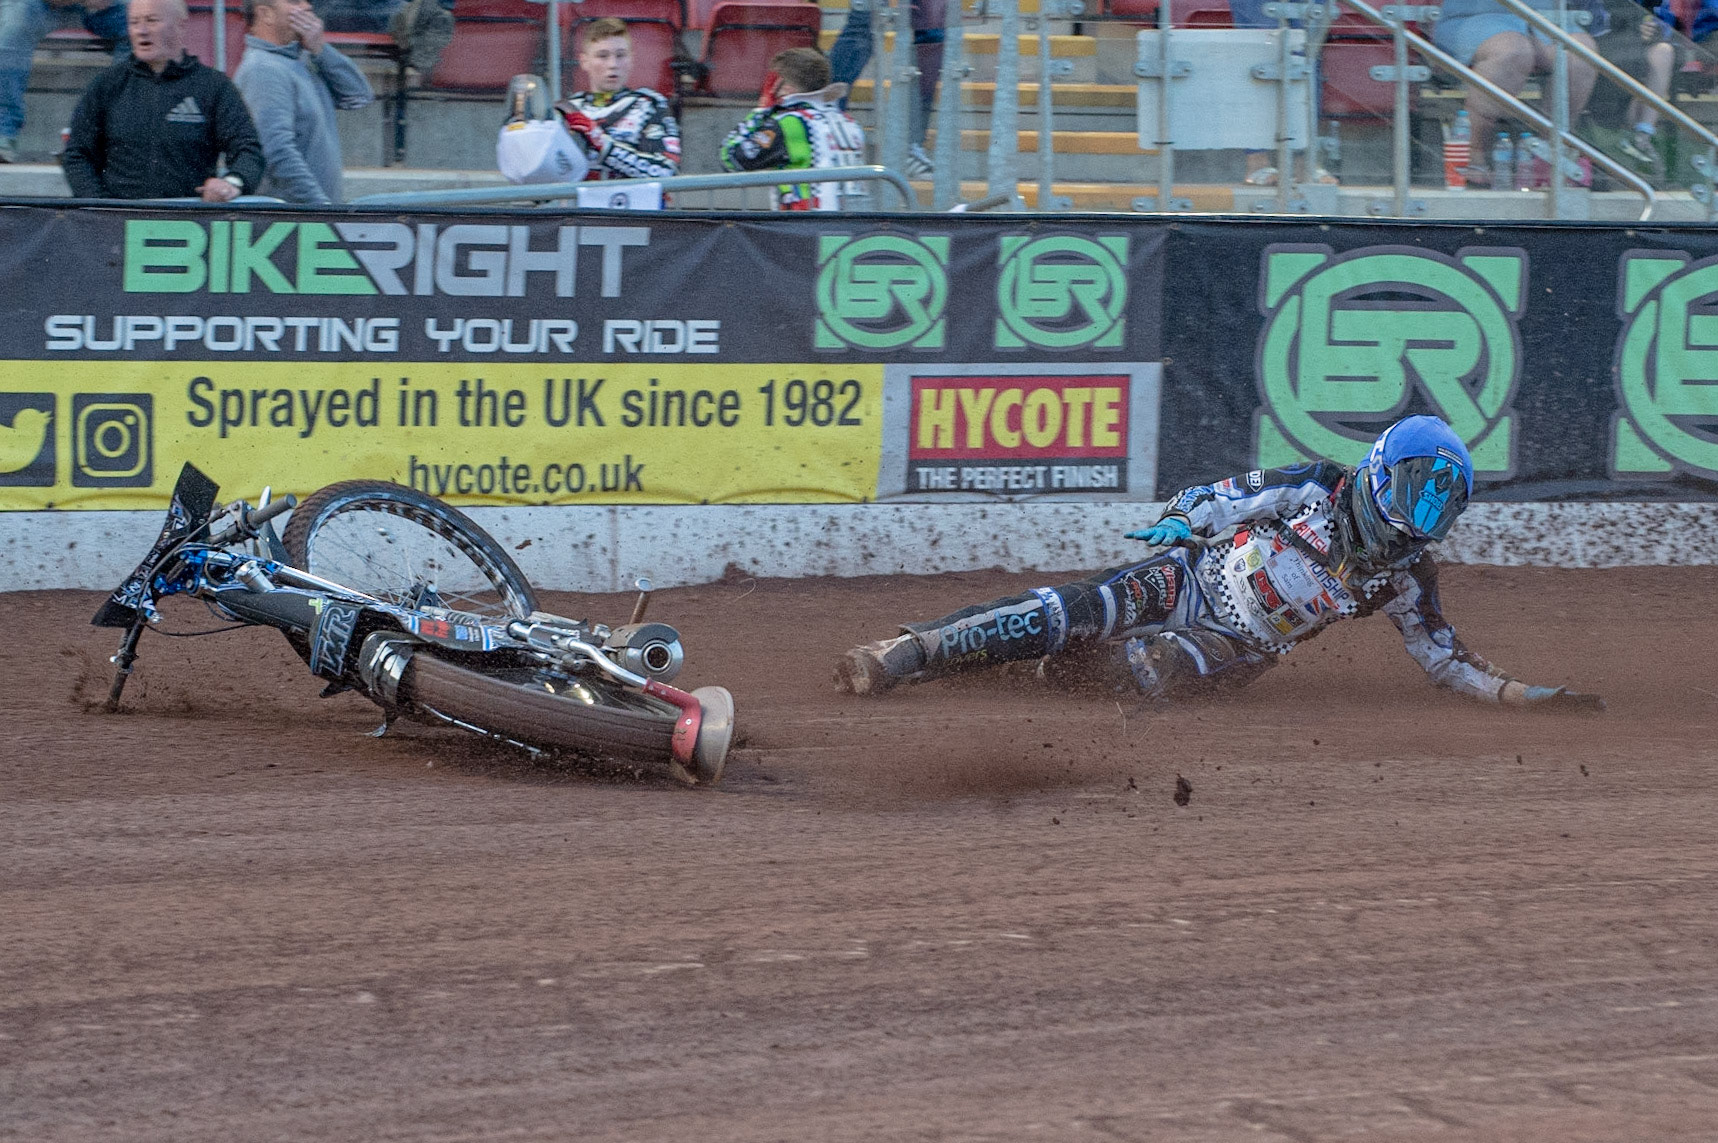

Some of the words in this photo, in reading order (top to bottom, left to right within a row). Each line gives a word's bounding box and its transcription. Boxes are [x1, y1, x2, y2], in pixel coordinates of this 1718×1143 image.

[45, 314, 399, 352] SUPPORTING
[425, 317, 578, 353] YOUR
[603, 319, 721, 354] RIDE
[187, 376, 381, 438] Sprayed
[399, 377, 438, 427] in
[455, 378, 526, 428] the
[544, 378, 607, 428] UK
[620, 378, 740, 428] since
[758, 379, 862, 427] 1982
[917, 387, 1122, 449] HYCOTE
[409, 454, 645, 497] hycote.co.uk
[915, 466, 958, 489] THE
[960, 466, 1049, 490] PERFECT
[1052, 465, 1119, 488] FINISH
